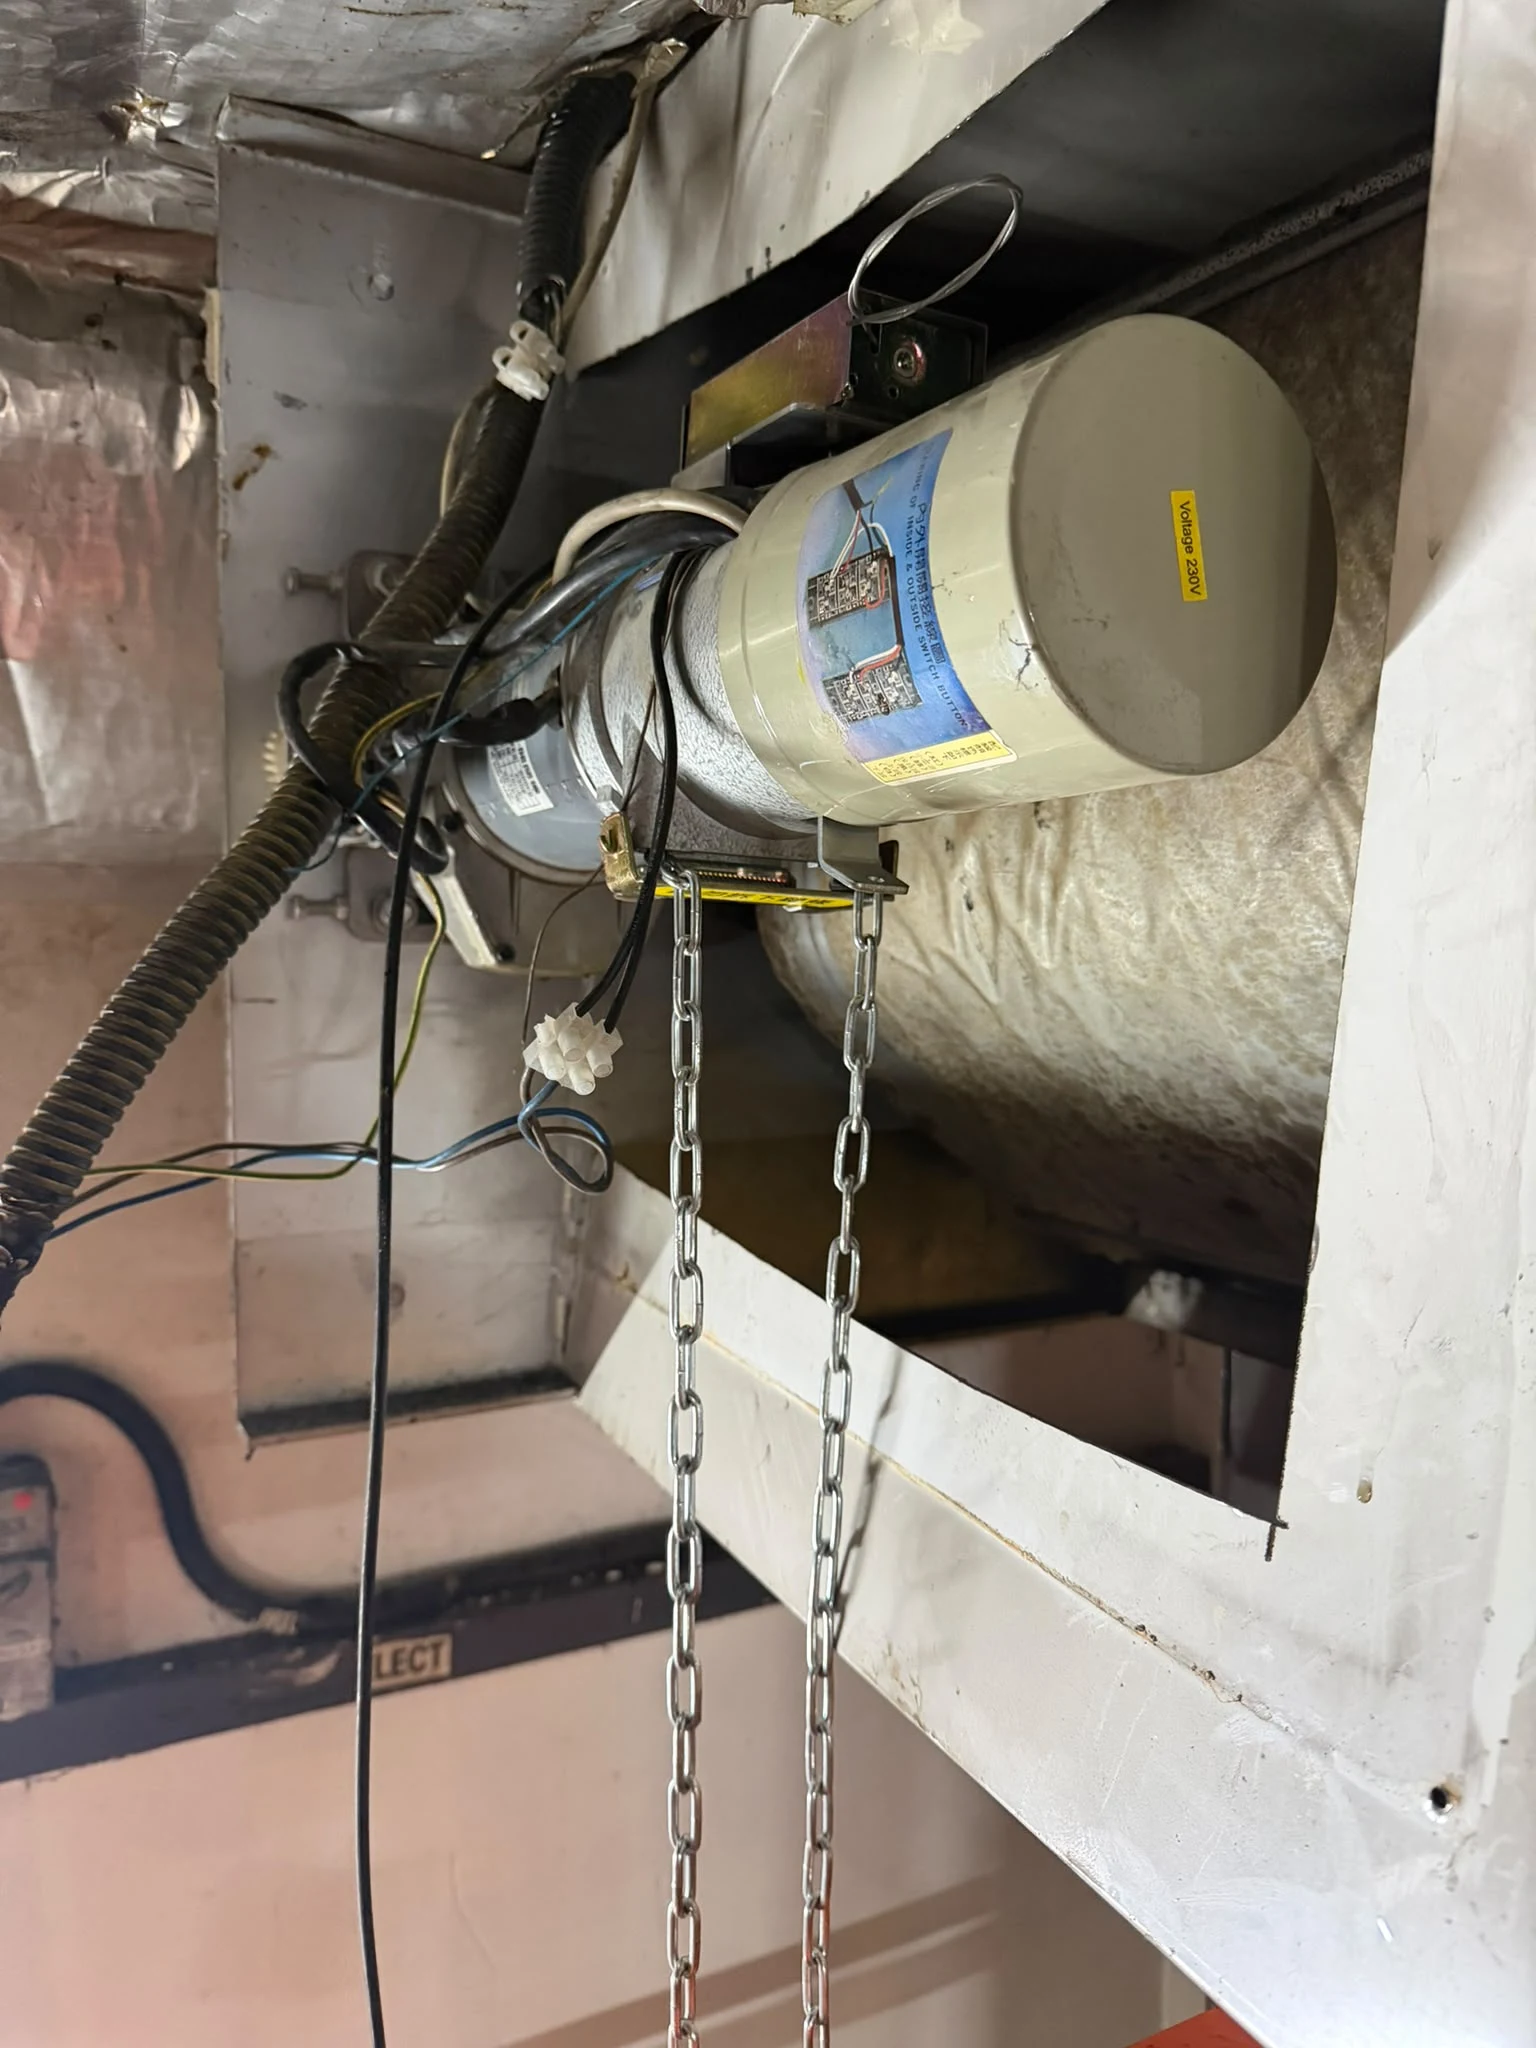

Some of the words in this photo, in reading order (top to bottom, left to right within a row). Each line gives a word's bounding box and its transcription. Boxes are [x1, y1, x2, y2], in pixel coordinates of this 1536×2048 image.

[905, 515, 914, 558] INSIDE
[1179, 500, 1194, 555] Voltage
[1185, 558, 1202, 597] 230V
[906, 576, 923, 631] OUTSIDE
[918, 635, 941, 681] SWITCH
[936, 684, 968, 727] BUTTON
